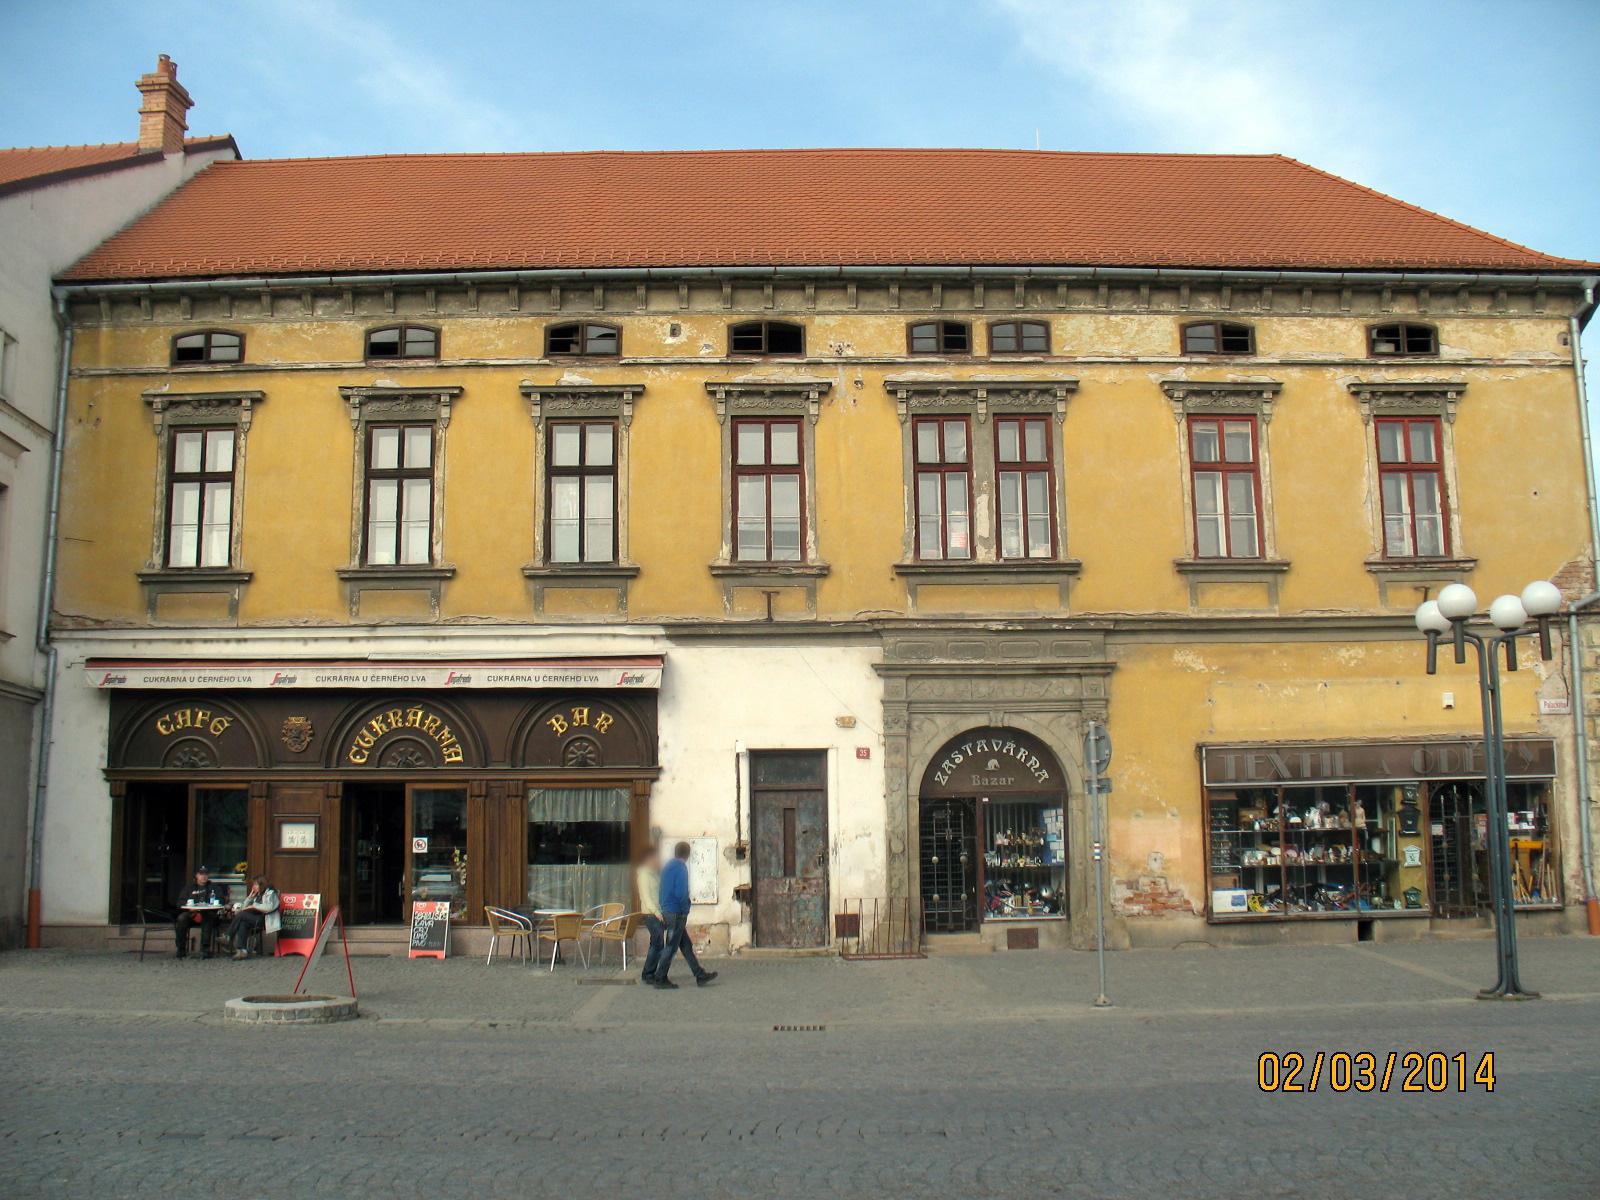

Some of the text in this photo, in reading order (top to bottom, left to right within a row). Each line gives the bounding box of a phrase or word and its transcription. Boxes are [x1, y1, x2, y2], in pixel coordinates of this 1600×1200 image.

[143, 674, 187, 683] CUKRÁRNA
[197, 673, 236, 683] ČERNÉHO
[315, 674, 360, 683] CUKRÁRNA
[370, 673, 409, 683] ČERNÉHO
[486, 673, 532, 682] CUKRÁRNA
[542, 672, 582, 682] ČERNÉHO
[156, 708, 234, 736] CAFÉ
[348, 704, 464, 764] CUKRÁRNA
[546, 707, 614, 737] BAR
[934, 738, 1050, 786] ZASTAVÁRNA
[1216, 751, 1354, 780] TEXTIL
[971, 775, 1015, 786] Bazar
